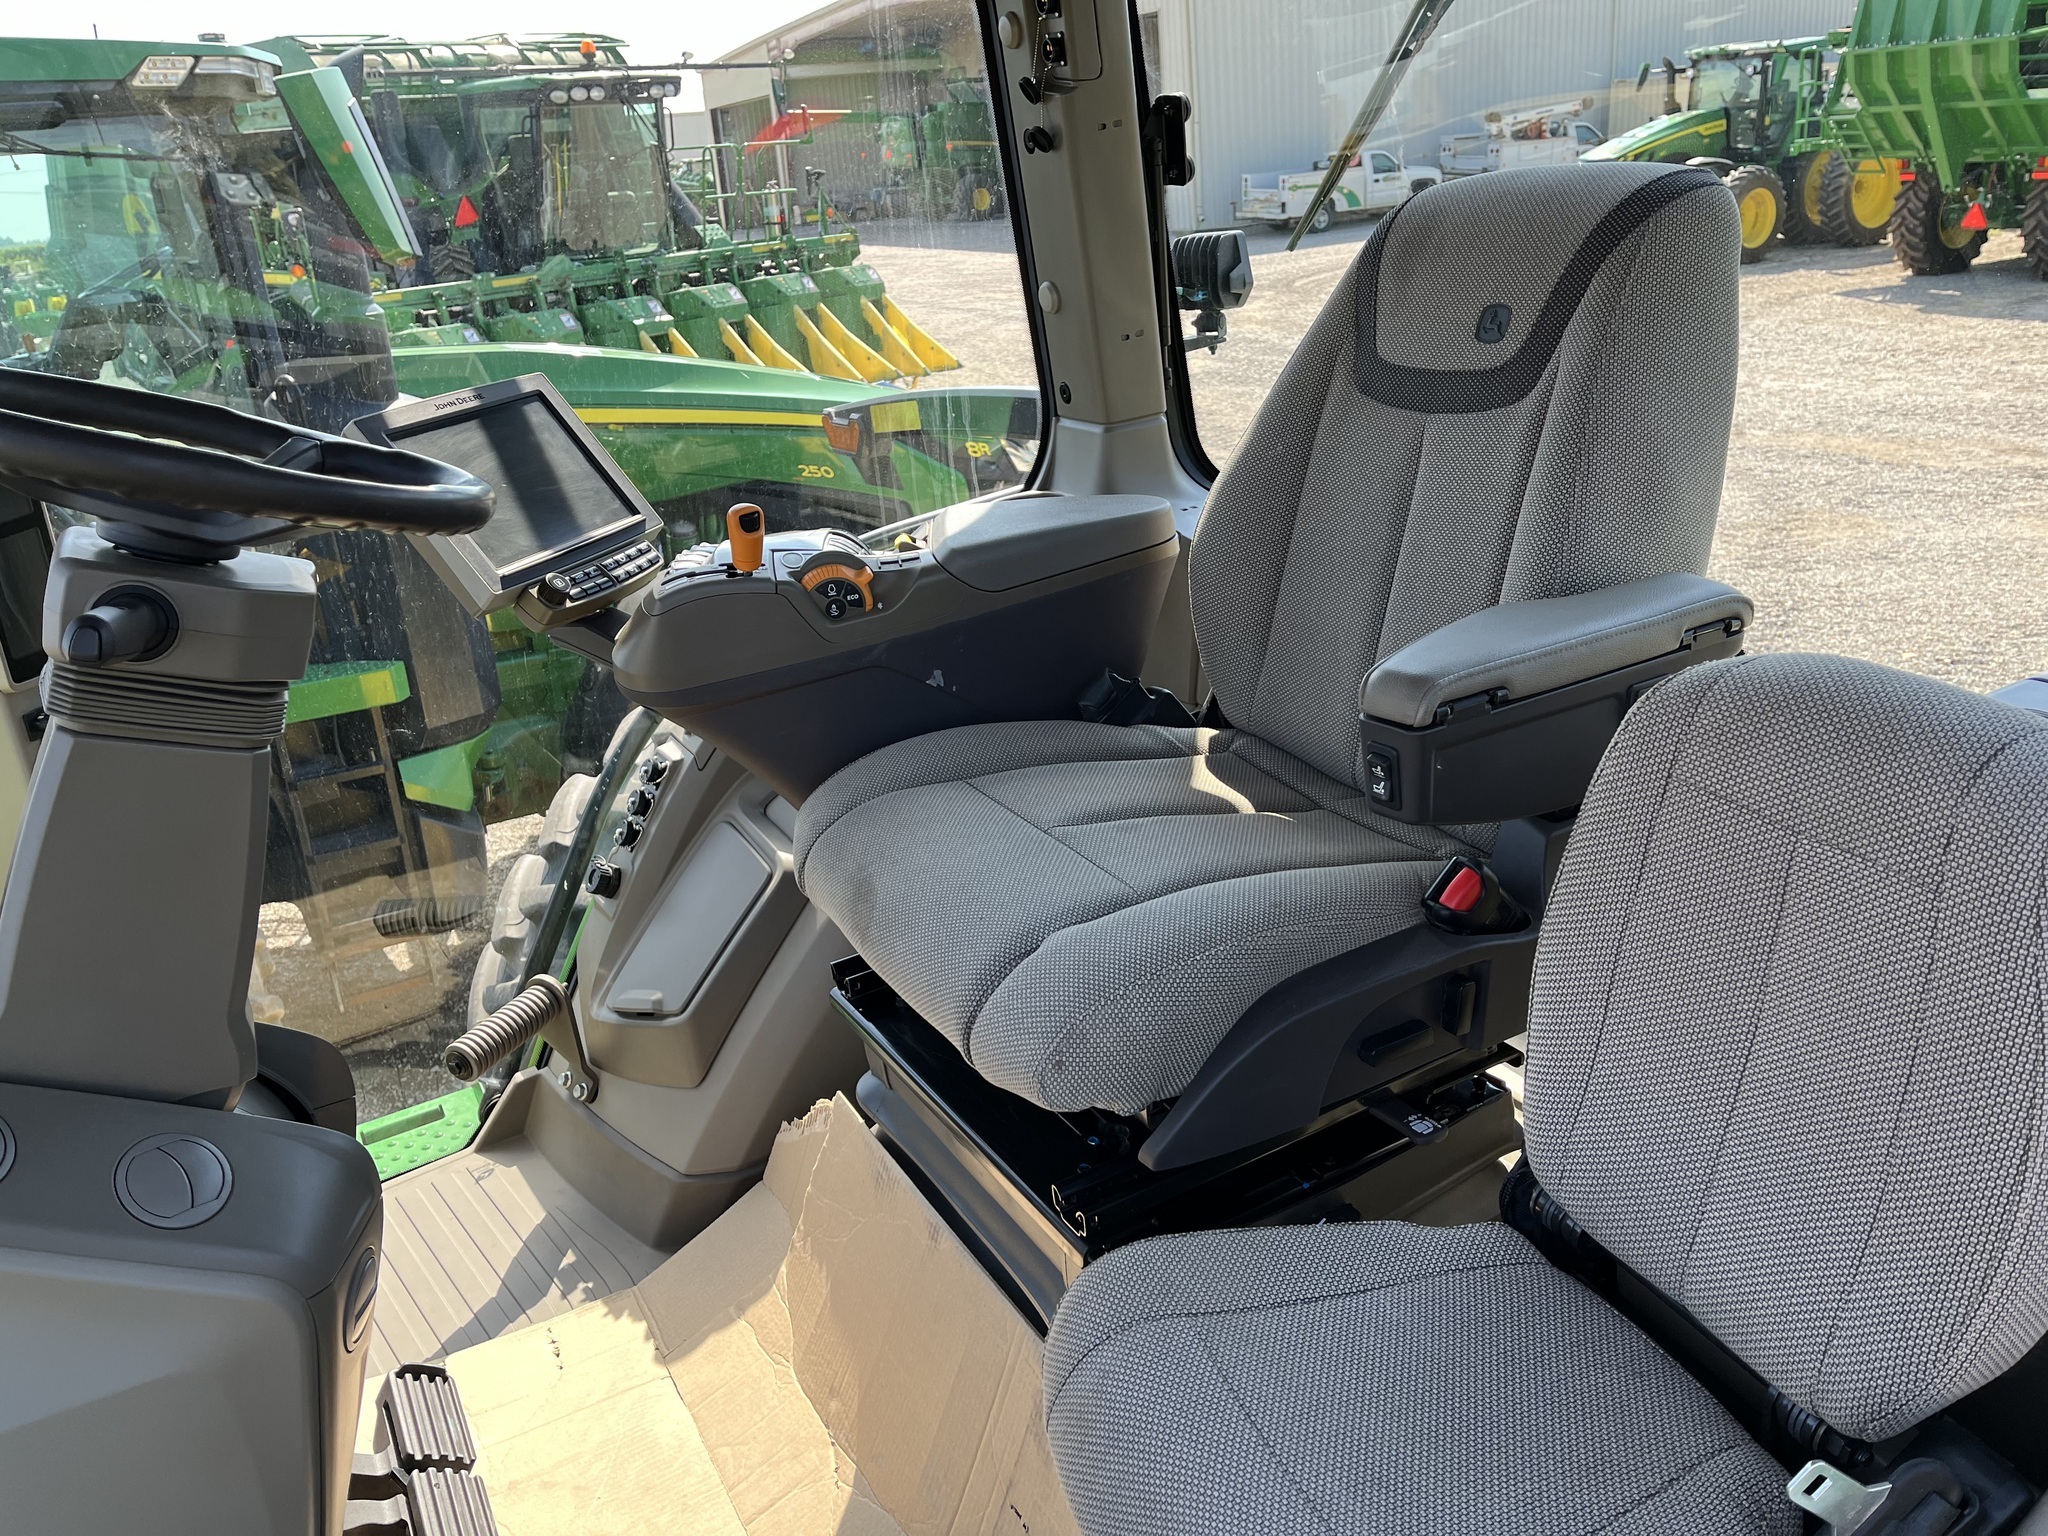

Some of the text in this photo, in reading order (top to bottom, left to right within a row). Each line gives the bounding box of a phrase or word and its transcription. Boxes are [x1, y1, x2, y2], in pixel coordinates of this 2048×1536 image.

[434, 393, 485, 411] JOHN DEERE
[965, 441, 992, 457] 8R
[798, 464, 835, 479] 250
